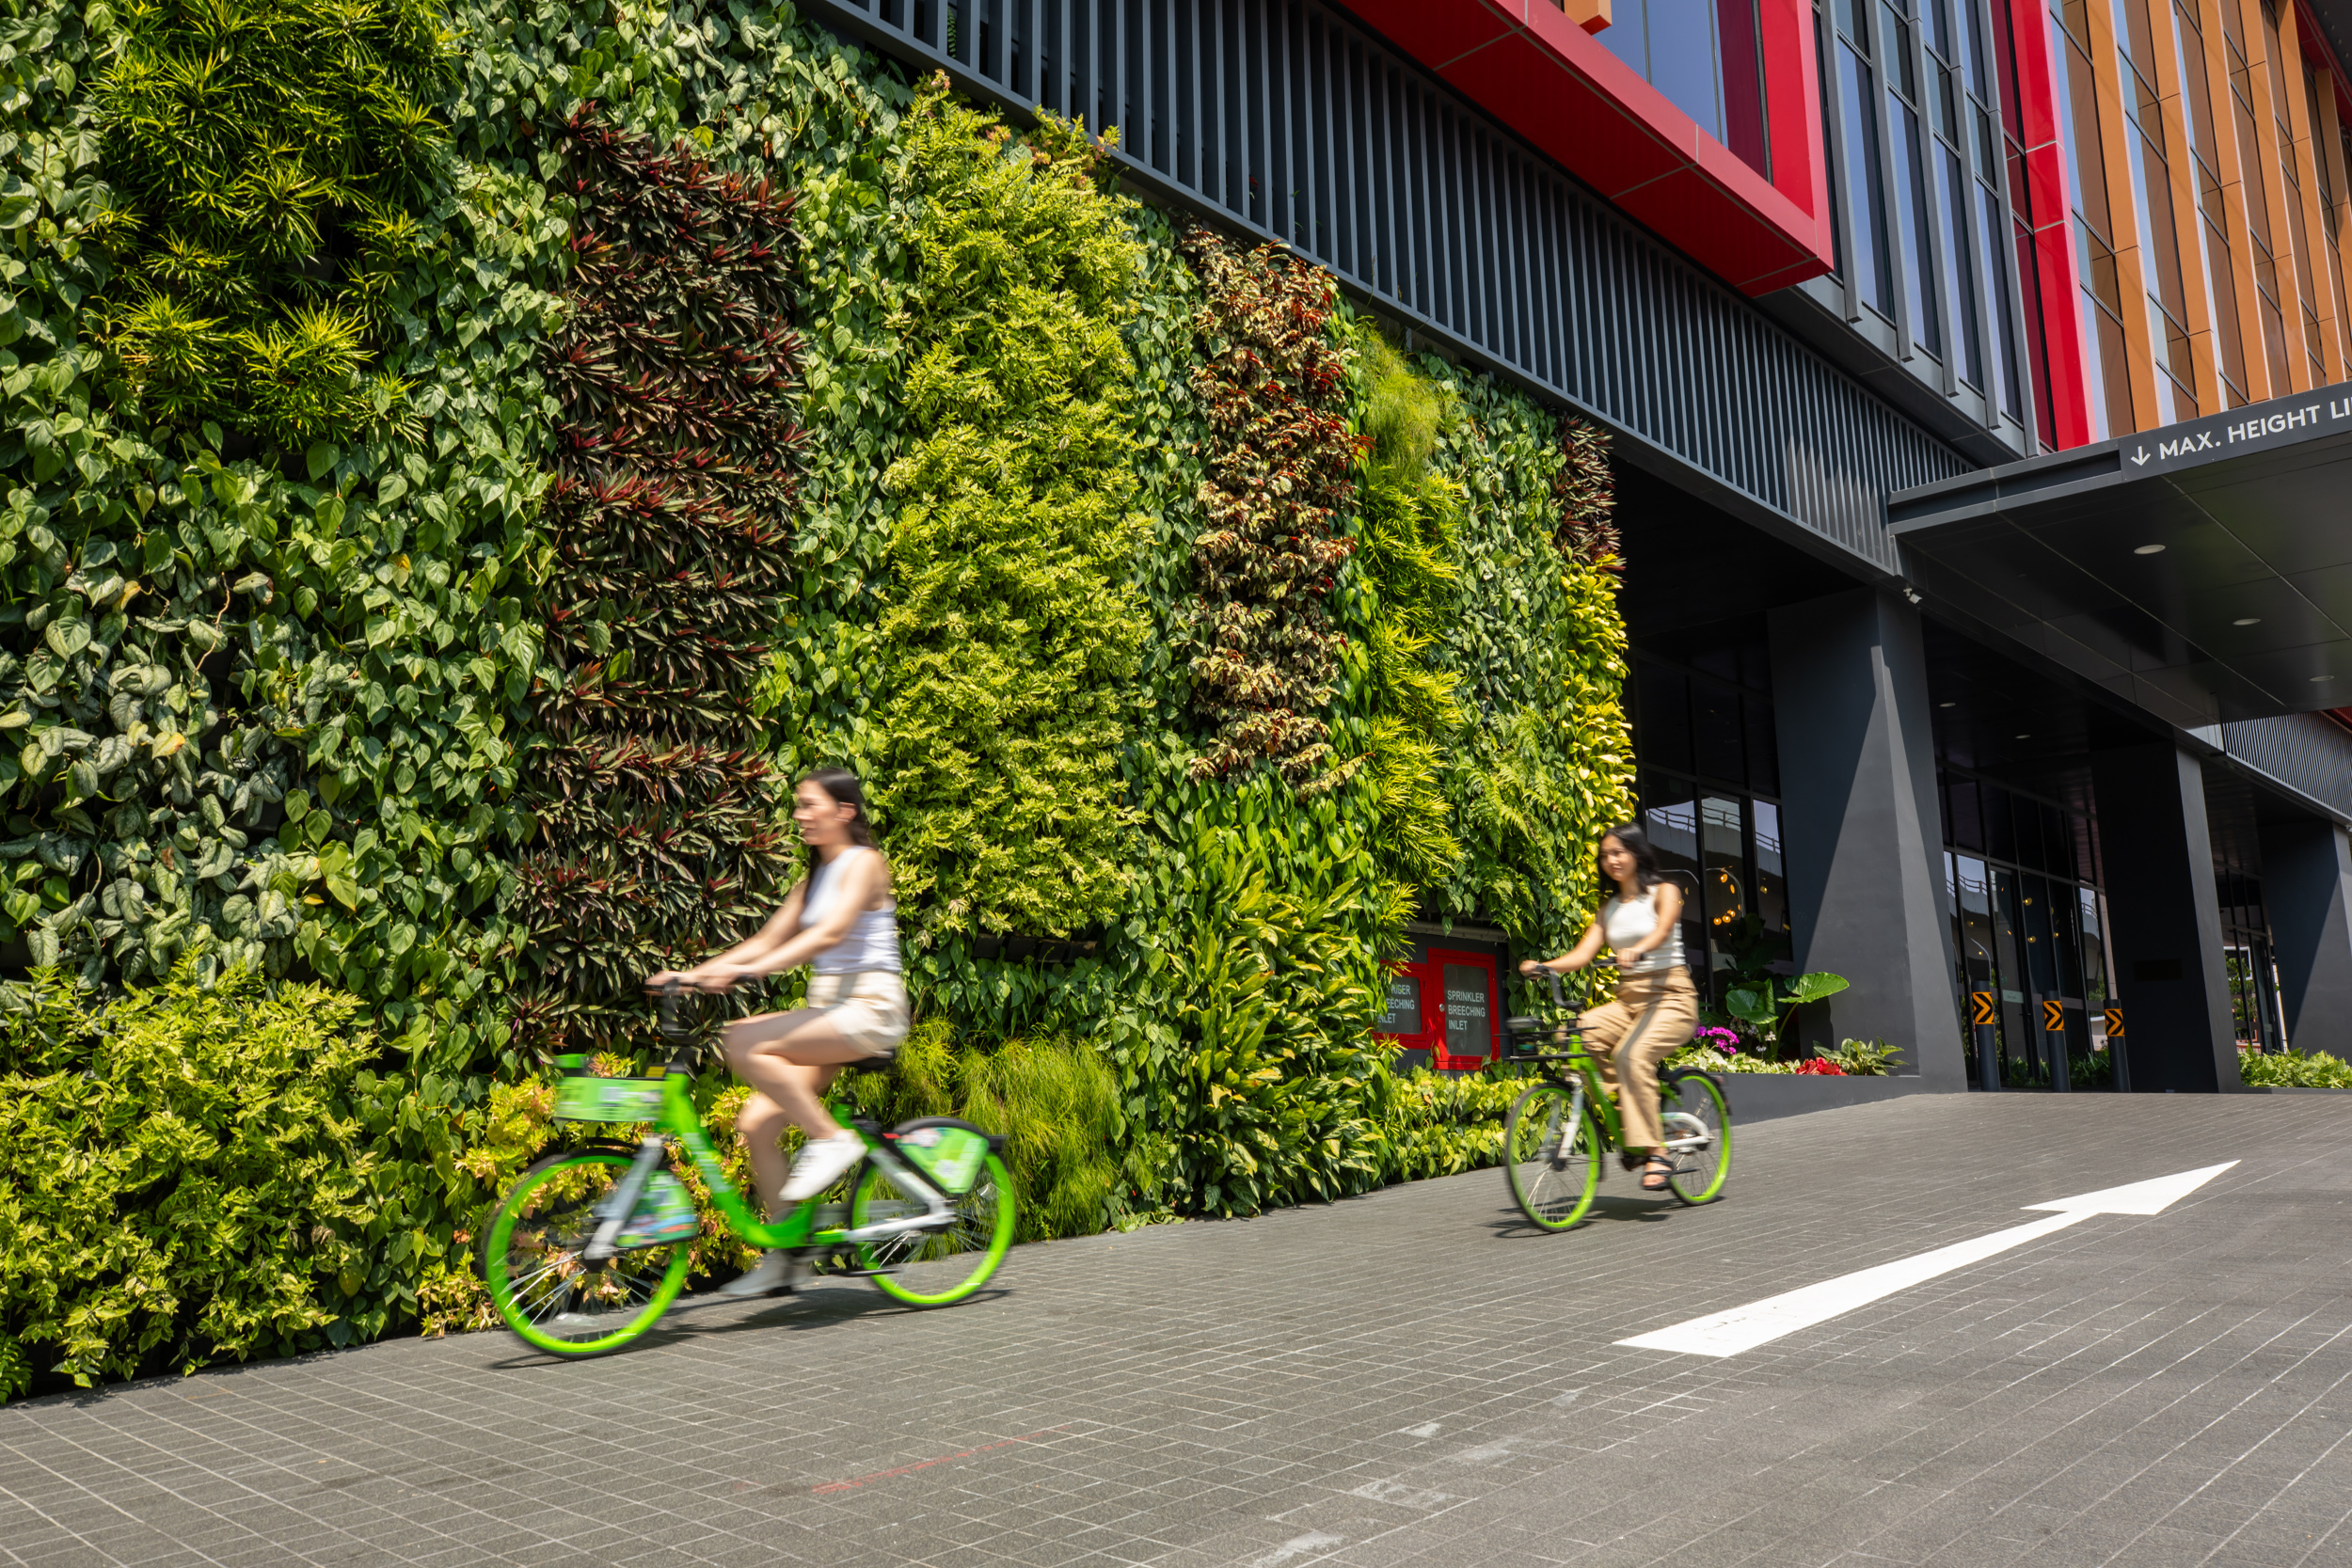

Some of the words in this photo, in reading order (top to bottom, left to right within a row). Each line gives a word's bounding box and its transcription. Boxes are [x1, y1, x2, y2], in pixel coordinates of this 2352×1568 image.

[2159, 431, 2221, 460] MAX.
[2228, 404, 2320, 443] HEIGHT
[2329, 396, 2352, 420] LI
[1391, 984, 1411, 995] RISER
[1447, 990, 1485, 1003] SPRINKLER
[1386, 998, 1415, 1010] EECHING
[1448, 1005, 1486, 1017] BREECHING
[1448, 1020, 1468, 1031] INLET
